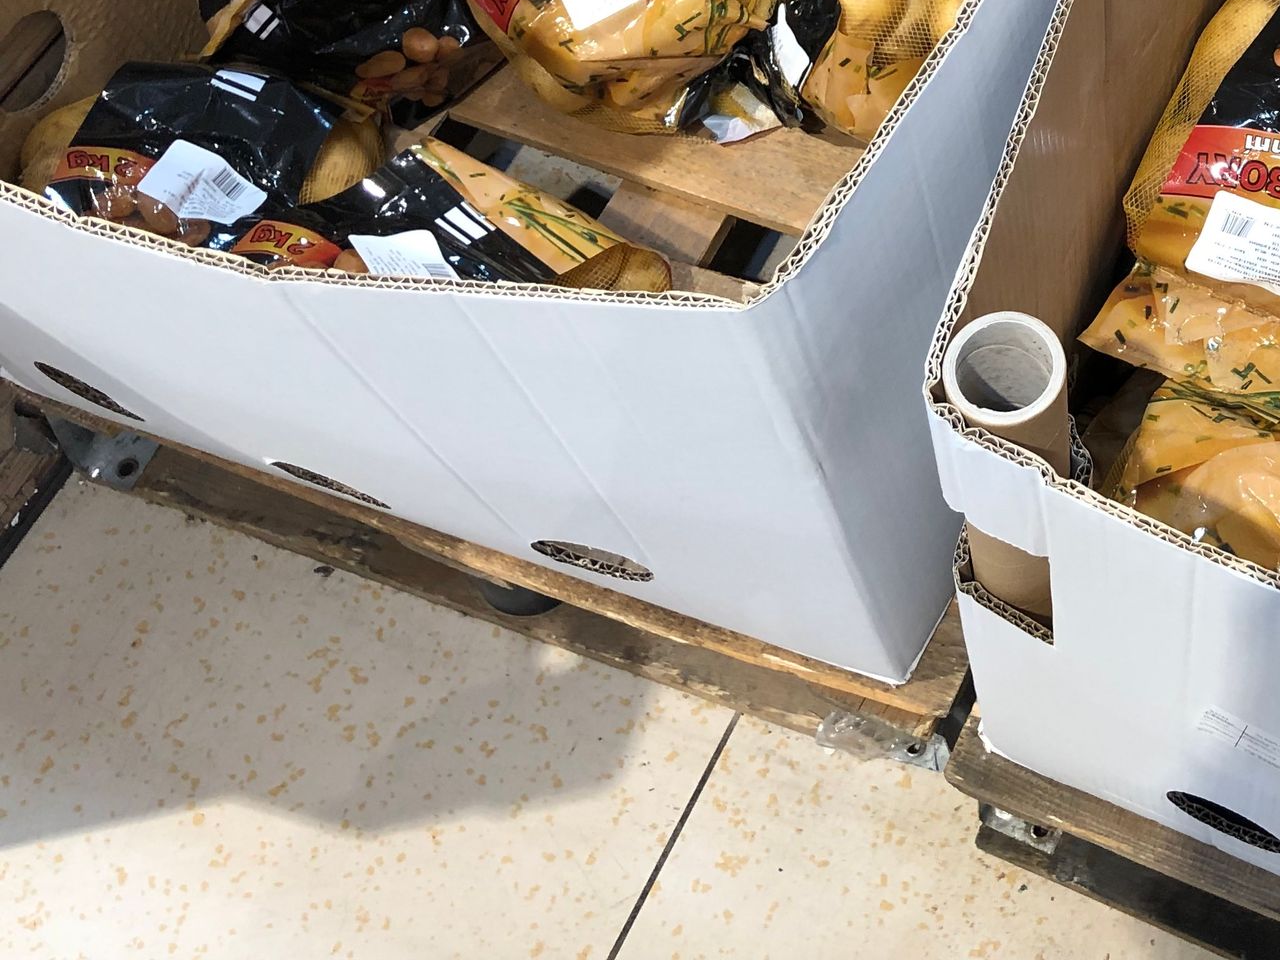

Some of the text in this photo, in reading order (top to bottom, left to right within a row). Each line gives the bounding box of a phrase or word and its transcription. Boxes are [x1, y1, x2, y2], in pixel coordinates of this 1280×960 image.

[66, 150, 138, 178] 2 kg
[250, 224, 316, 254] 2 kg
